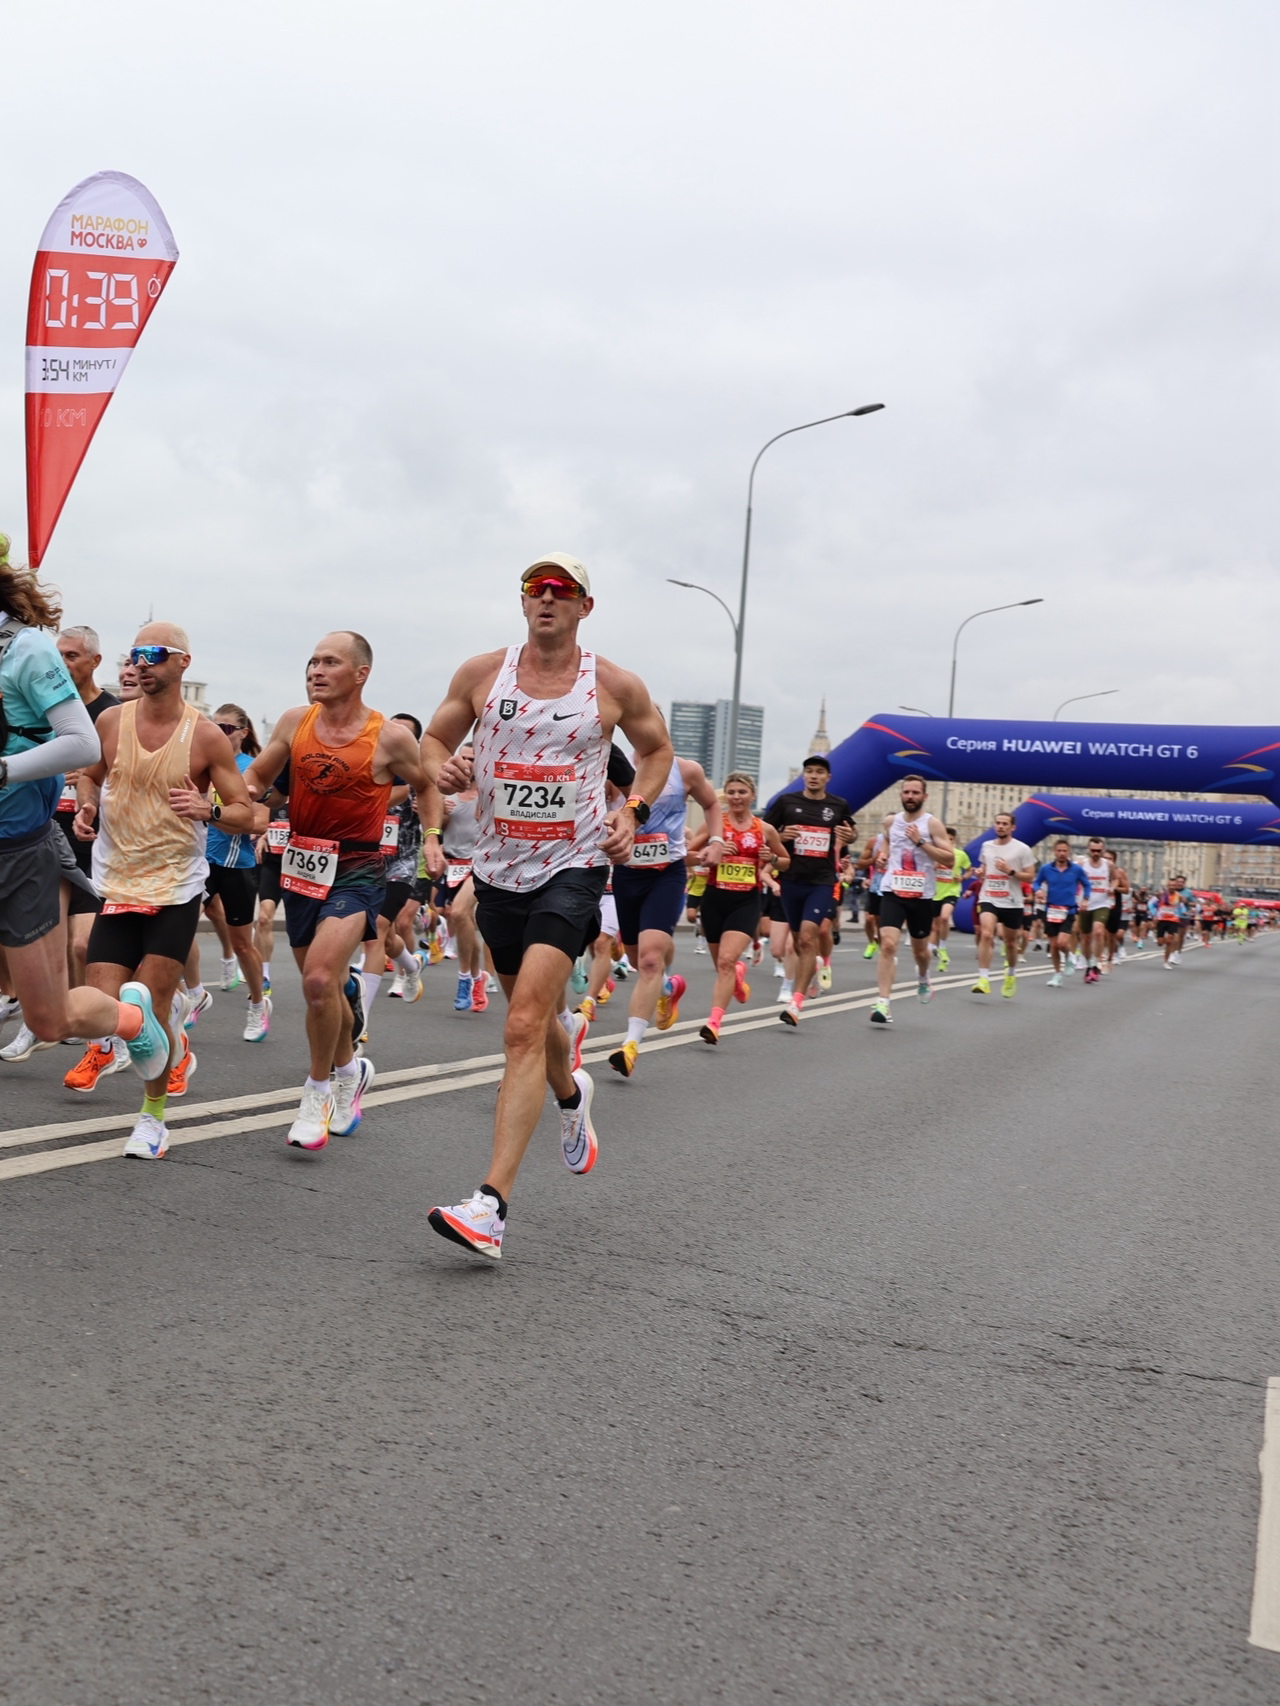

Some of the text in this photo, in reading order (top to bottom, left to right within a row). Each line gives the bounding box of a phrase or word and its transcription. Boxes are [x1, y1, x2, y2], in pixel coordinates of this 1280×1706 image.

[71, 214, 149, 235] МАРАФОН
[70, 231, 134, 251] МОСКВА
[45, 268, 140, 330] 0:39
[73, 372, 88, 382] КМ
[946, 736, 1199, 759] Серия HUAWEI WATCH GT 6
[301, 753, 350, 772] GOLDEN RING
[504, 783, 566, 808] 7234
[510, 809, 557, 819] ВЛАДИСЛАВ
[1081, 808, 1242, 825] Серия HUAWEI WATCH GT 6
[633, 844, 668, 858] 6473
[286, 848, 329, 874] 7369
[720, 864, 755, 878] 10975
[894, 876, 923, 888] 11025
